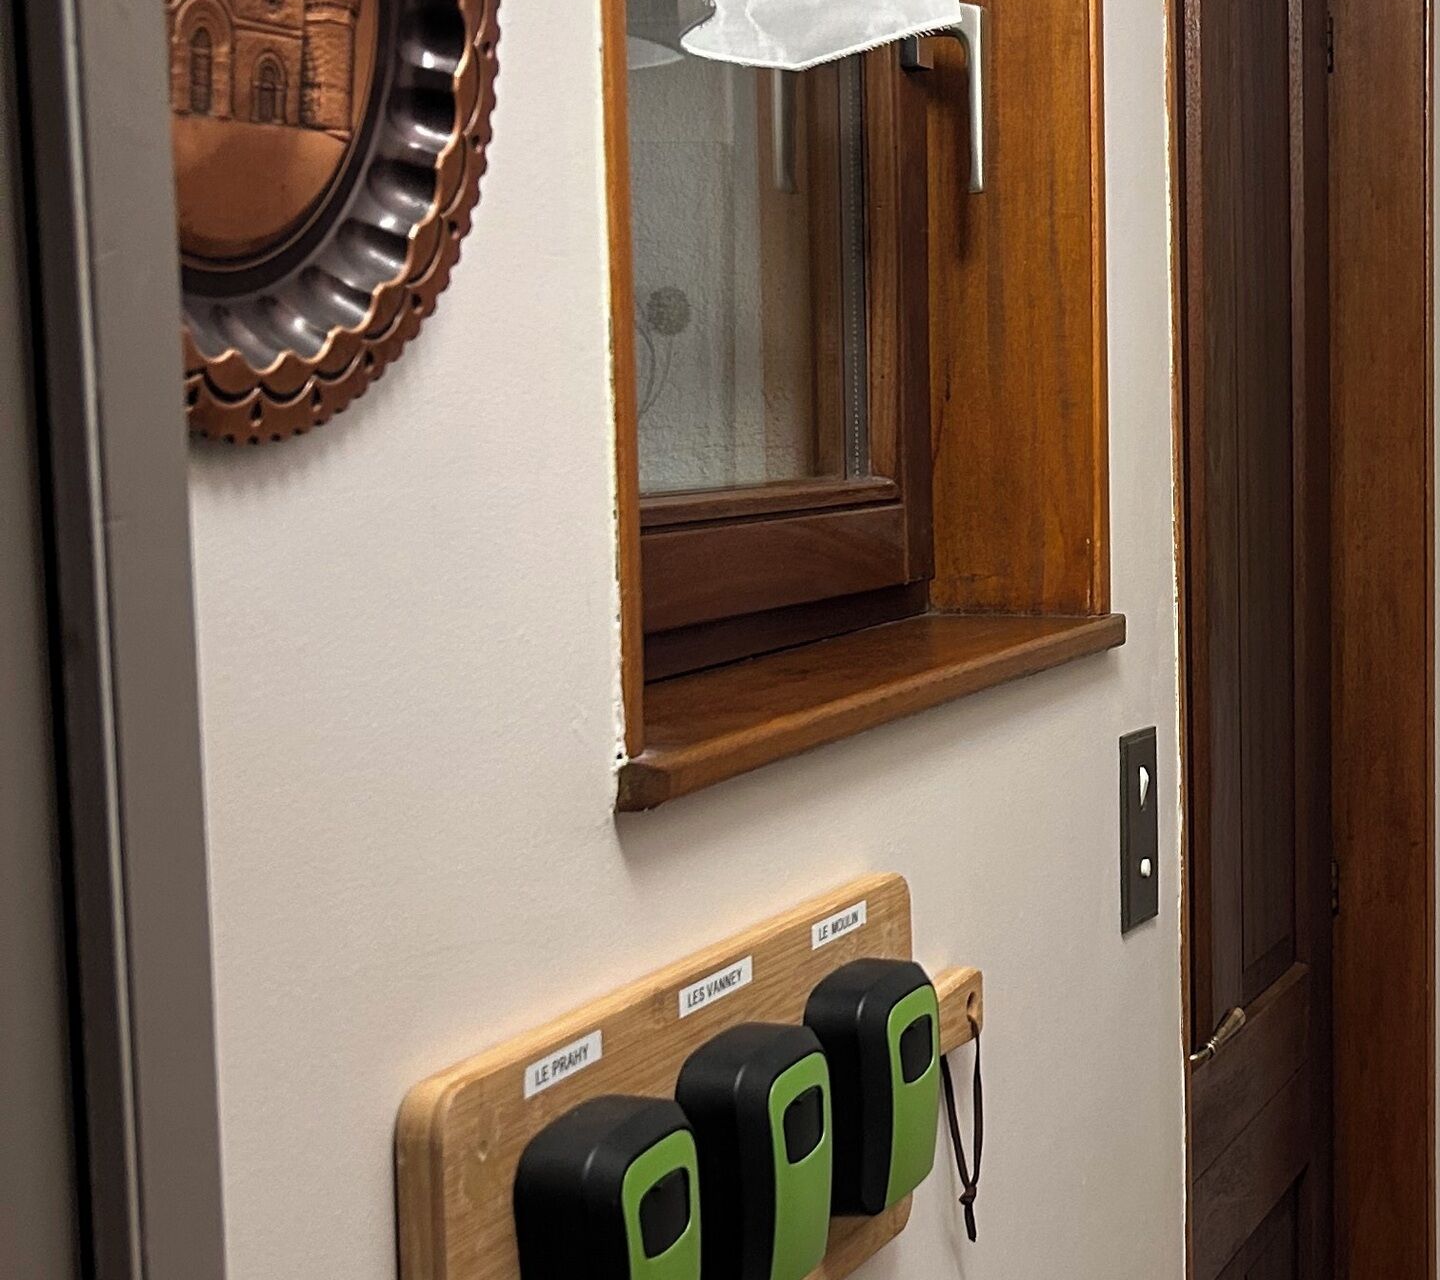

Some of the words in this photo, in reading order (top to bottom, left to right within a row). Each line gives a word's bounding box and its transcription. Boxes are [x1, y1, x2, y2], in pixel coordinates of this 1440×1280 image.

[817, 926, 829, 942] LE
[831, 909, 860, 935] MOULIN
[687, 986, 706, 1008] LES
[707, 966, 744, 997] VANNEY
[534, 1067, 551, 1086] LE
[552, 1042, 591, 1076] PRAHY
